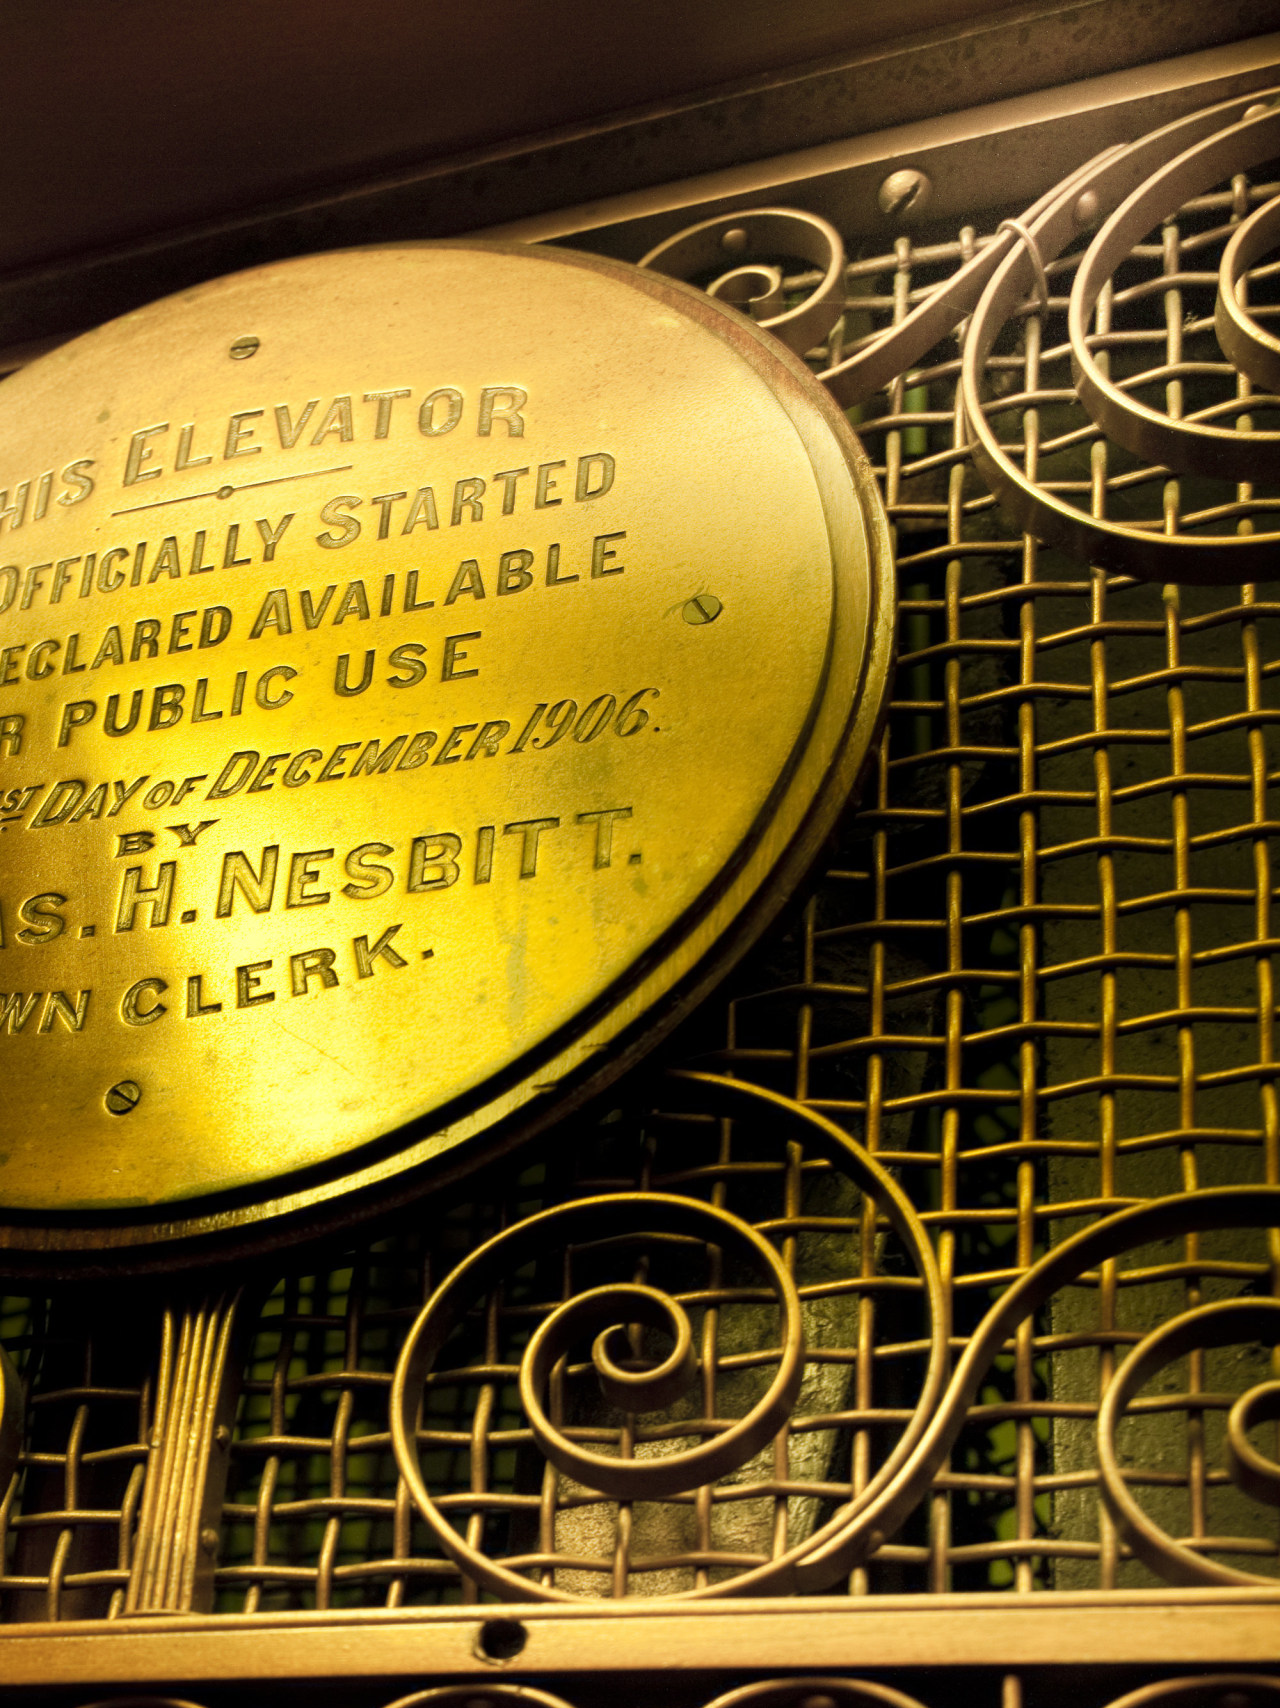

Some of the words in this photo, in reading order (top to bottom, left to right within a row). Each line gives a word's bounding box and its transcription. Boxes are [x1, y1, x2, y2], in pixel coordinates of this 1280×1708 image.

[123, 385, 528, 487] ELEVATOR
[315, 451, 617, 549] STARTED
[247, 530, 628, 641] AVAILABLE
[57, 664, 299, 749] PUBLIC
[333, 631, 484, 698] USE
[28, 774, 151, 831] DAY
[141, 774, 210, 812] OF
[203, 718, 513, 802] DECEMBER
[507, 686, 664, 756] 1906.
[114, 817, 222, 860] BY
[114, 862, 197, 936] H.
[216, 804, 644, 917] NESBITT.
[121, 922, 436, 1028] CLERK.
